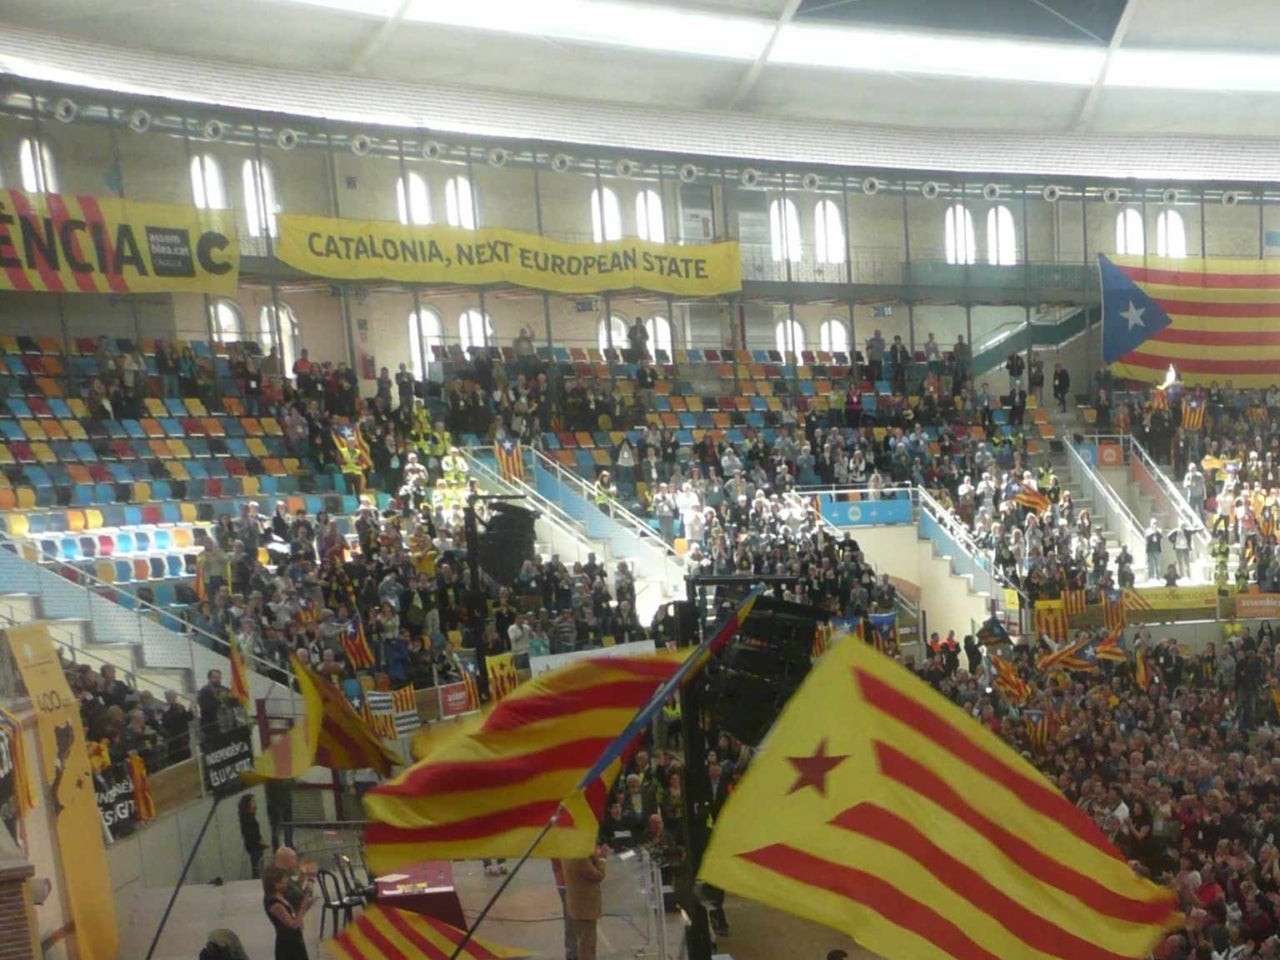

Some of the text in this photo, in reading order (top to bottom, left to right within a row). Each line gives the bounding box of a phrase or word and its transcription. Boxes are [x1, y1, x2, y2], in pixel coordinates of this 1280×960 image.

[308, 232, 709, 279] CATALONIA, NEXT EUROPEAN STATE
